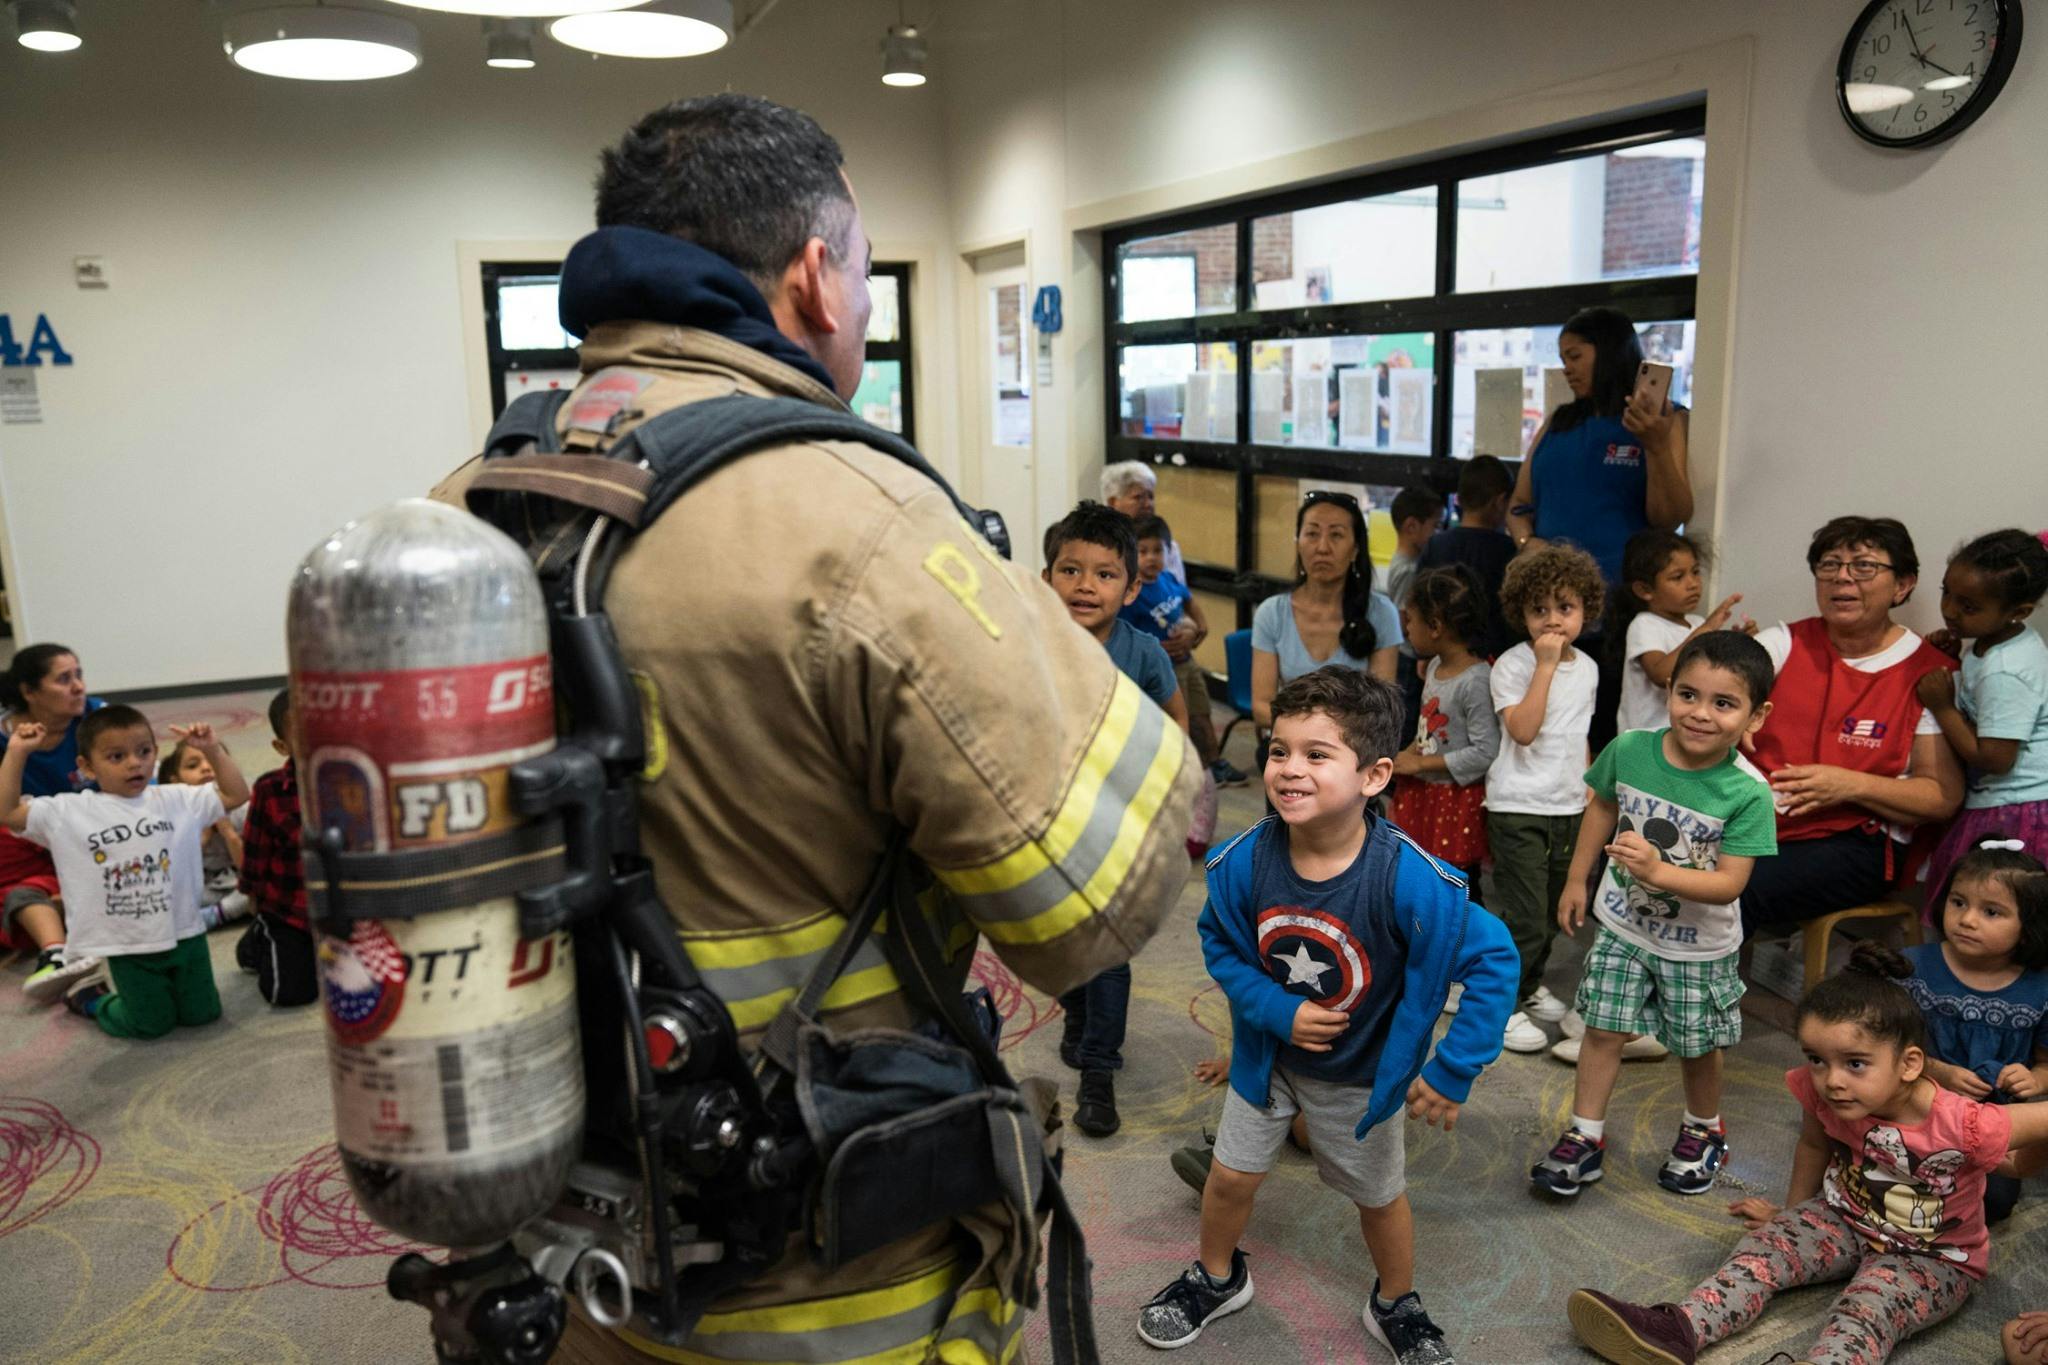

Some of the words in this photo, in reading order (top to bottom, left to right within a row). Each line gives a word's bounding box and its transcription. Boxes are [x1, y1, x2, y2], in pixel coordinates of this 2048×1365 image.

[1915, 0, 1935, 16] 12
[1963, 4, 1979, 26] 2
[1871, 34, 1891, 56] 10
[1971, 31, 1986, 52] 3
[1863, 65, 1878, 84] 9
[1962, 61, 1977, 81] 4
[1941, 90, 1955, 109] 5
[1913, 103, 1928, 123] 6
[0, 312, 73, 367] 4A
[397, 777, 489, 839] FD
[87, 823, 132, 852] SED
